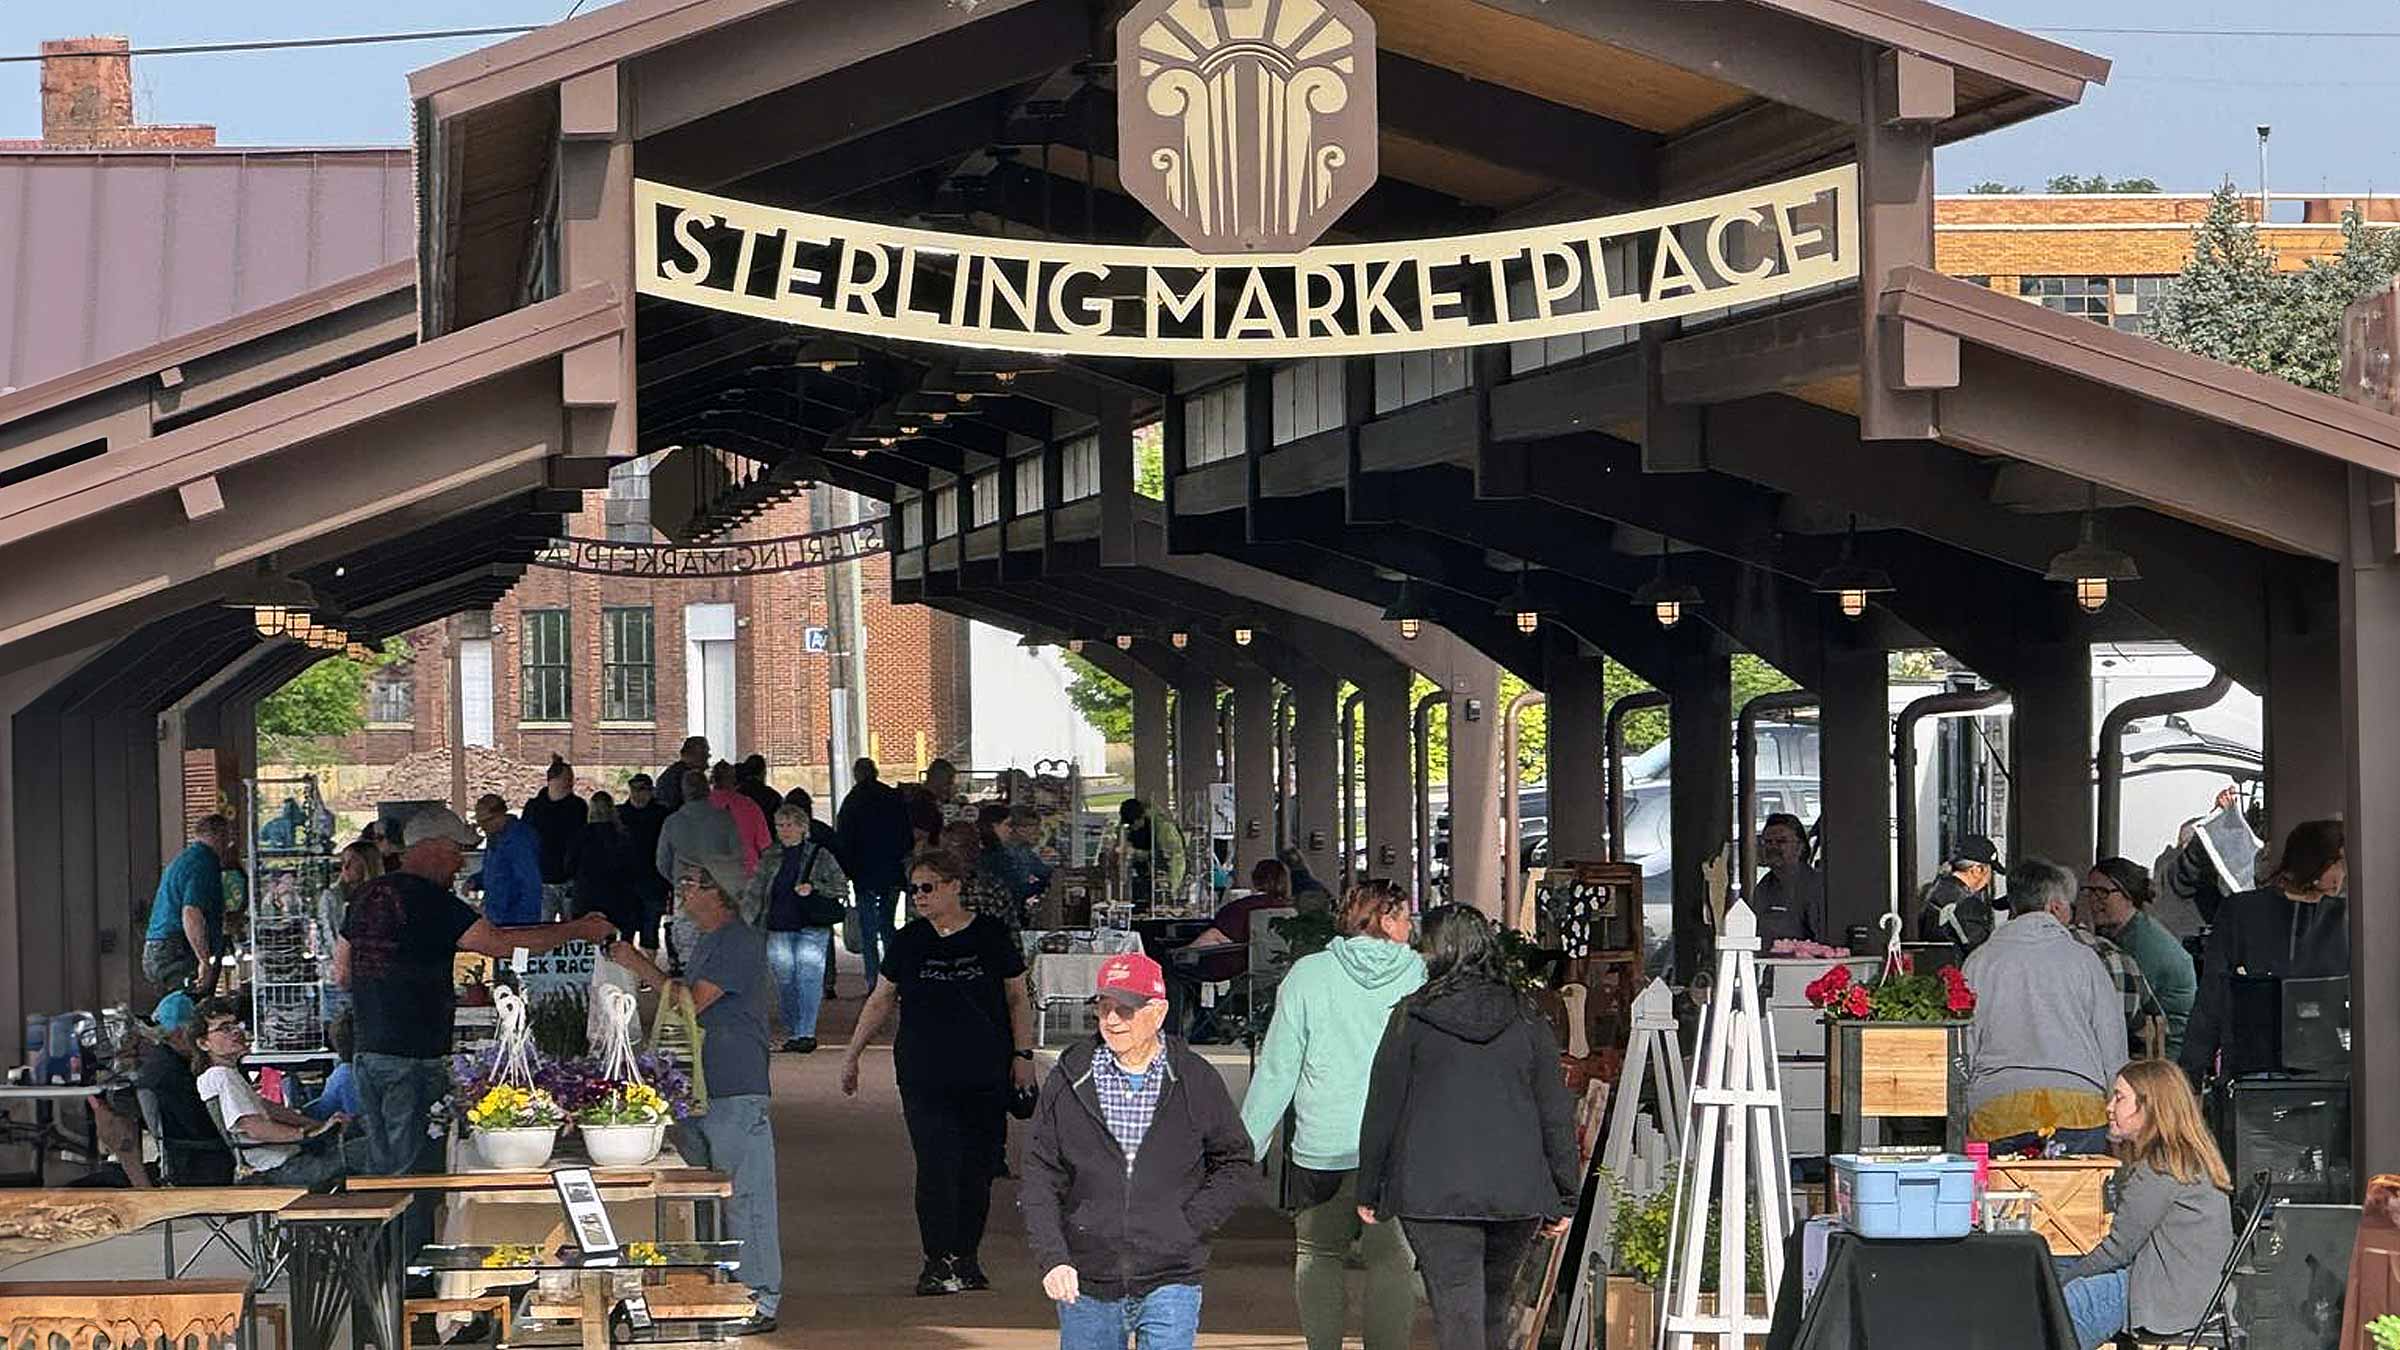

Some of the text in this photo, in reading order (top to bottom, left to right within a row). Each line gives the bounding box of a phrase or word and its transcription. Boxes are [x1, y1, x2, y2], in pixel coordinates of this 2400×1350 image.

[660, 194, 1833, 340] STERLING MARKETPLACE
[553, 941, 595, 957] RIVE
